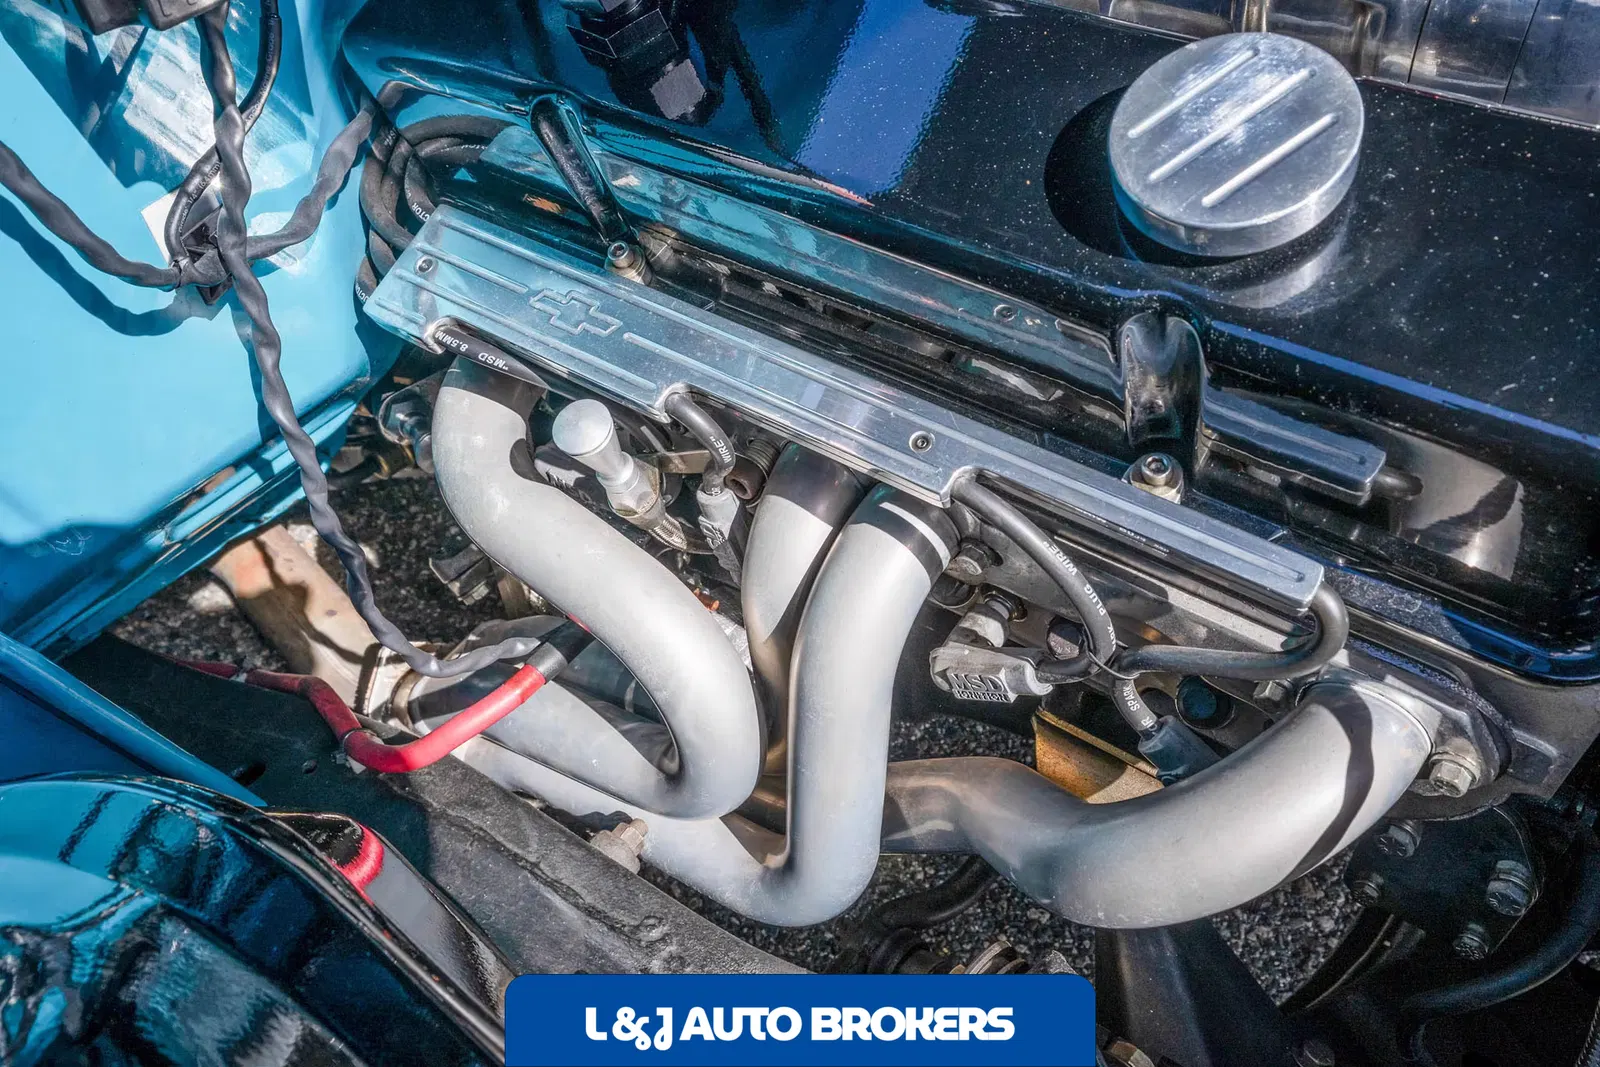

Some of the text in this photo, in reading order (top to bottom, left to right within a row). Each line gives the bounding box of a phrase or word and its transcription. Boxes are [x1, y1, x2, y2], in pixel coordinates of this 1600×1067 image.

[434, 330, 468, 352] 8.5MM
[1083, 584, 1106, 616] PLUG
[948, 672, 1006, 693] MSD
